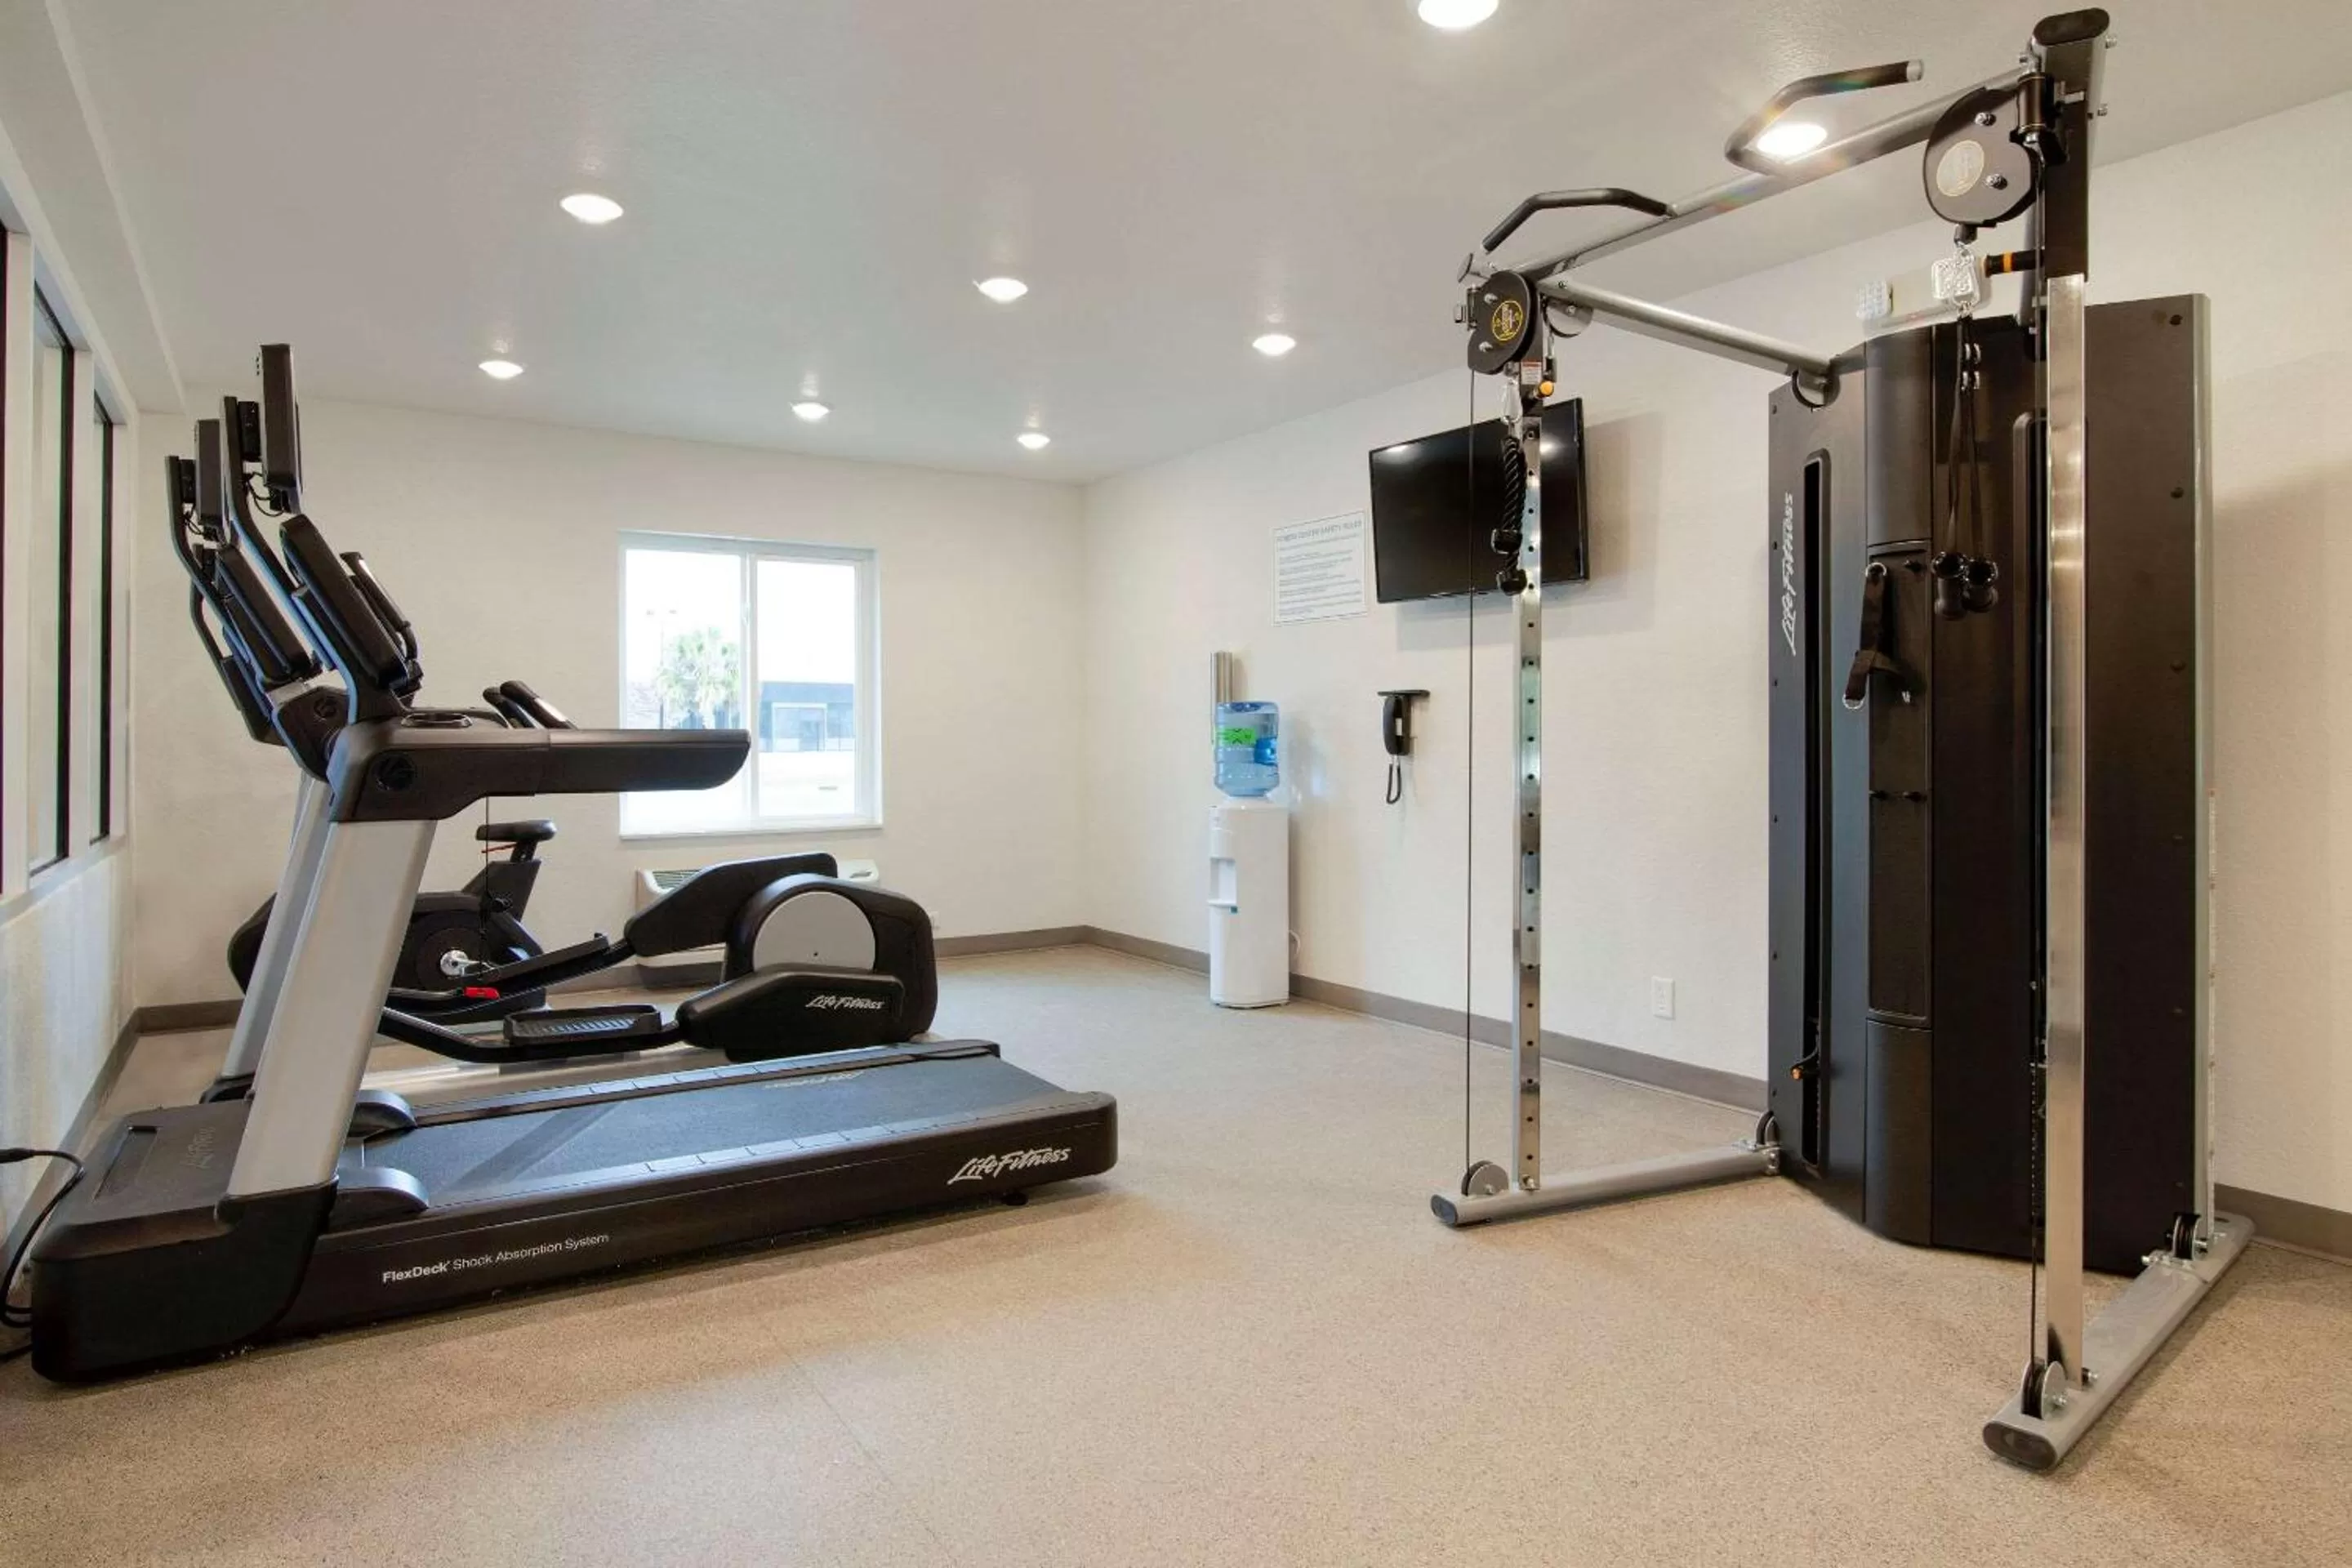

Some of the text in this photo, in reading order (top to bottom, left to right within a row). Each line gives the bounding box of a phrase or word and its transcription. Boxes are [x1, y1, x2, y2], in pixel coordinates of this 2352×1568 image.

[452, 1254, 493, 1270] Shock
[496, 1241, 563, 1264] Absorption
[564, 1232, 610, 1250] System
